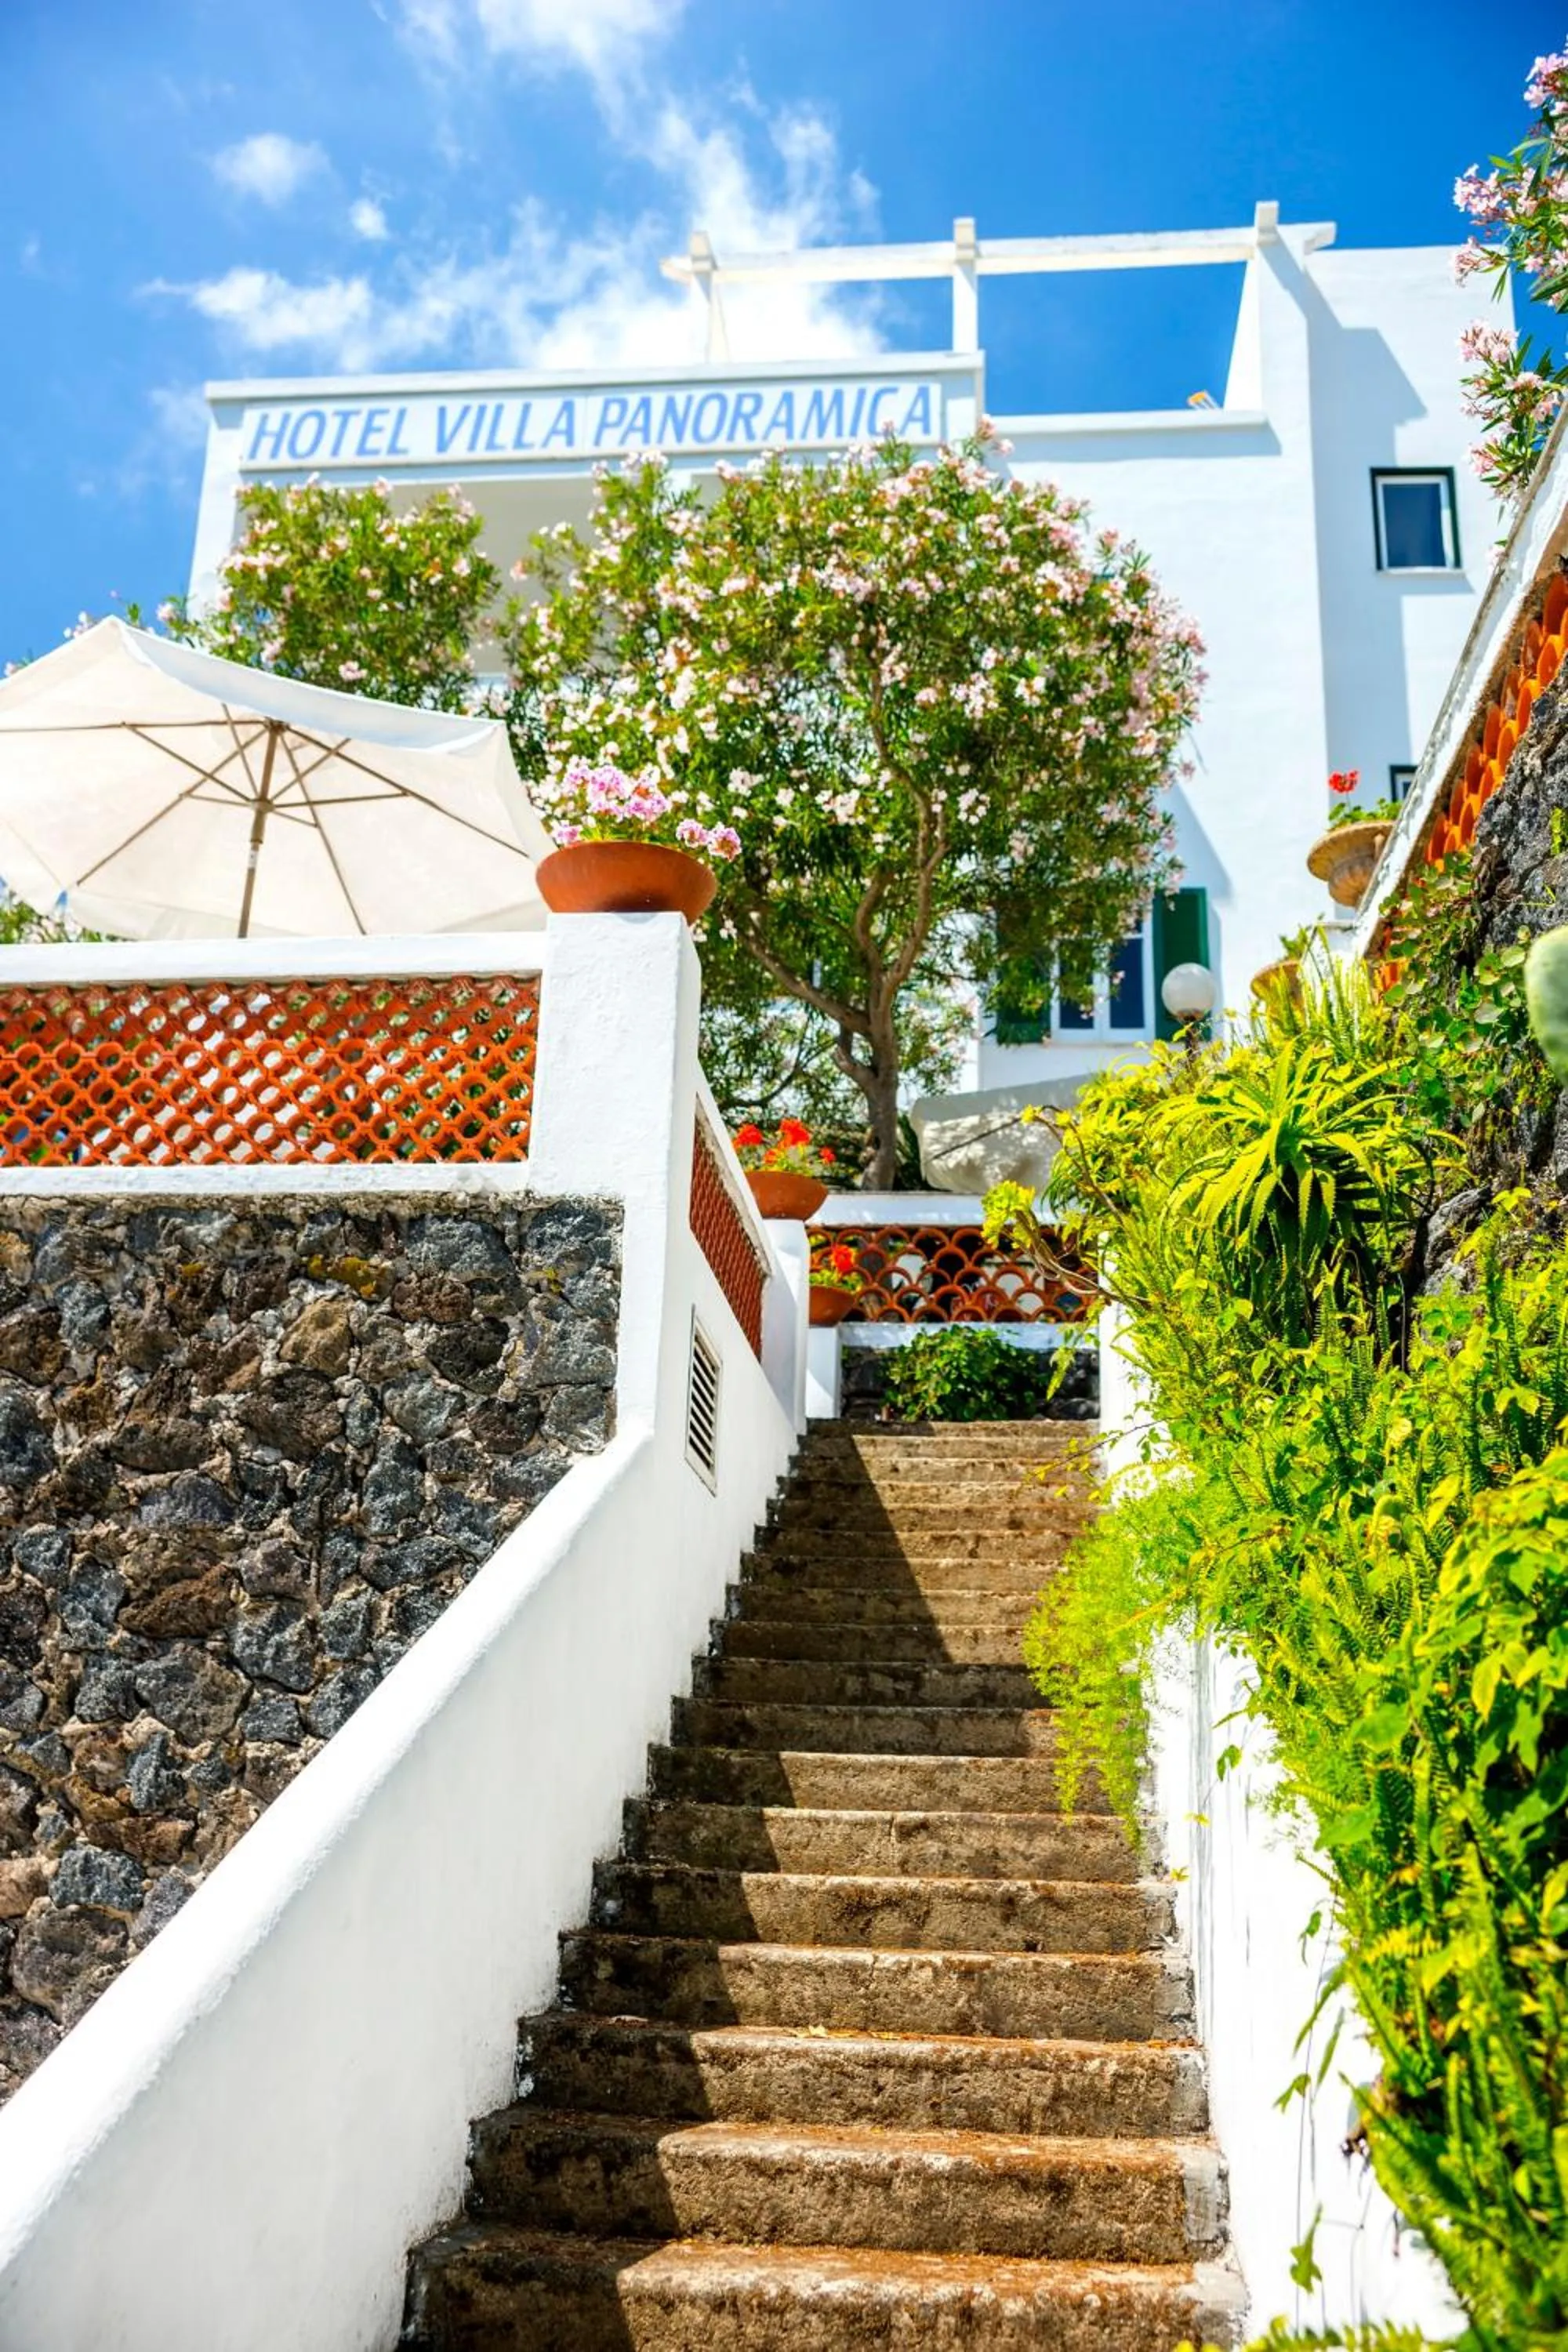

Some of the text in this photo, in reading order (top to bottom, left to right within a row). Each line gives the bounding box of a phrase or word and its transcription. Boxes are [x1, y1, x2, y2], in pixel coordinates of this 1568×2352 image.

[249, 384, 932, 460] HOTEL VILLA PANORAMICA
